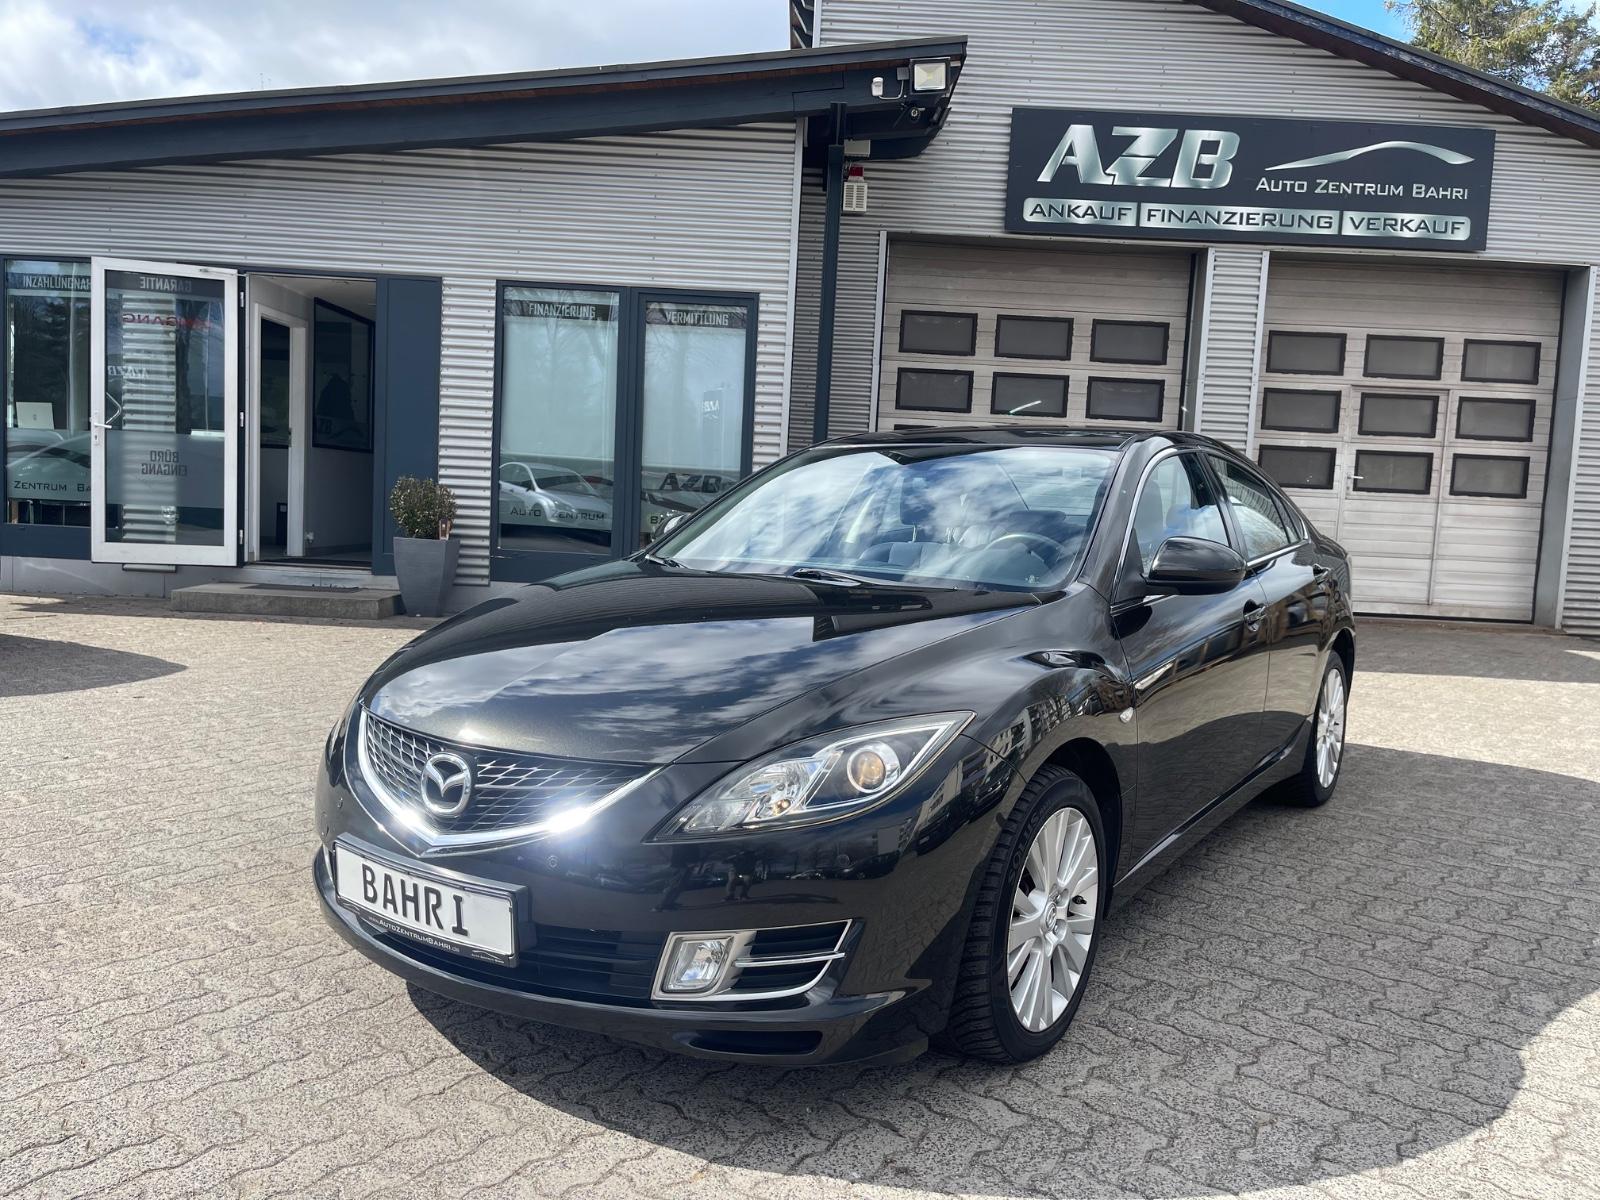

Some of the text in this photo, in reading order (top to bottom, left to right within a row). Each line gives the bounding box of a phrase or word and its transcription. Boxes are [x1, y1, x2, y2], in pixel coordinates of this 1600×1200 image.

[1037, 124, 1240, 190] AZB
[1256, 177, 1469, 200] AUTO ZENTRUM BAHRI
[1029, 203, 1466, 235] ANKAUF FINANZIERUNG VERKAUF
[528, 303, 596, 318] FINANZIERUNG
[665, 311, 729, 326] VERMITTLUNG
[14, 480, 67, 492] ZENTRUM
[659, 472, 722, 494] AZB
[510, 506, 605, 521] AUTO ZENTRUM
[361, 863, 469, 937] BAHRI
